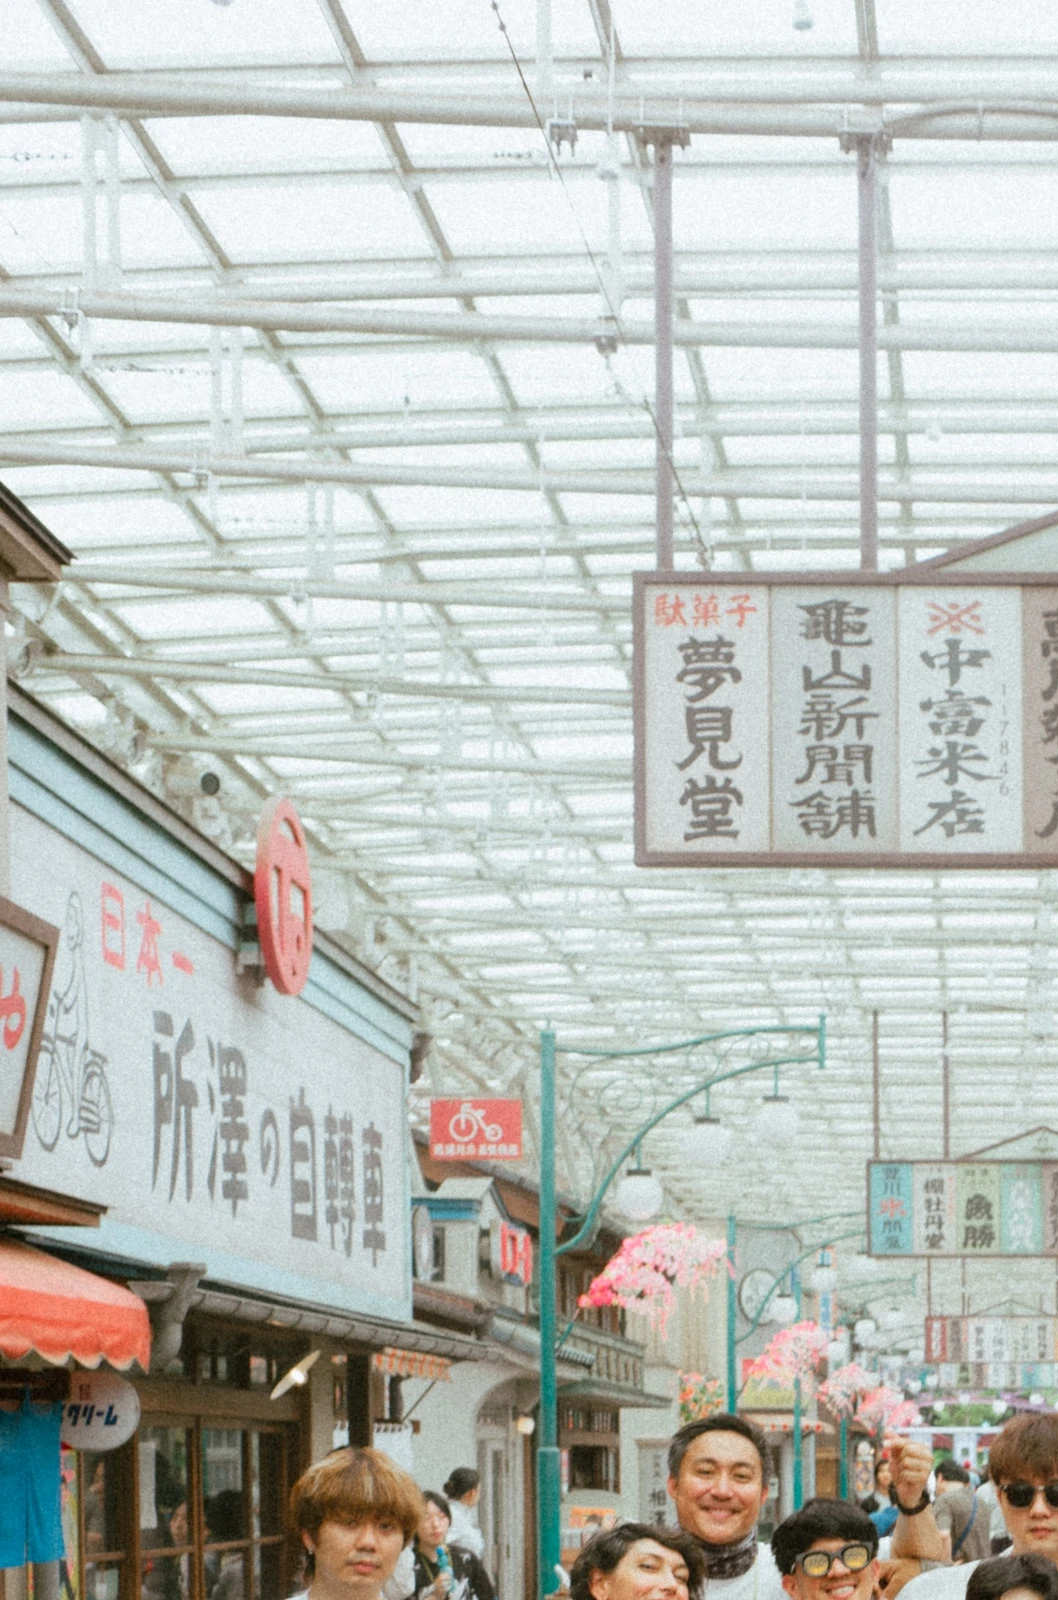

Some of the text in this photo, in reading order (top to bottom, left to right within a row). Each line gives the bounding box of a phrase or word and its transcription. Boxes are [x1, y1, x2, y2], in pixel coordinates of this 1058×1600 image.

[654, 593, 757, 629] 駄菓子
[673, 635, 744, 842] 夢見堂
[912, 637, 1002, 839] 中富米店
[102, 881, 195, 988] 日本一
[62, 1404, 118, 1427] クリーム
